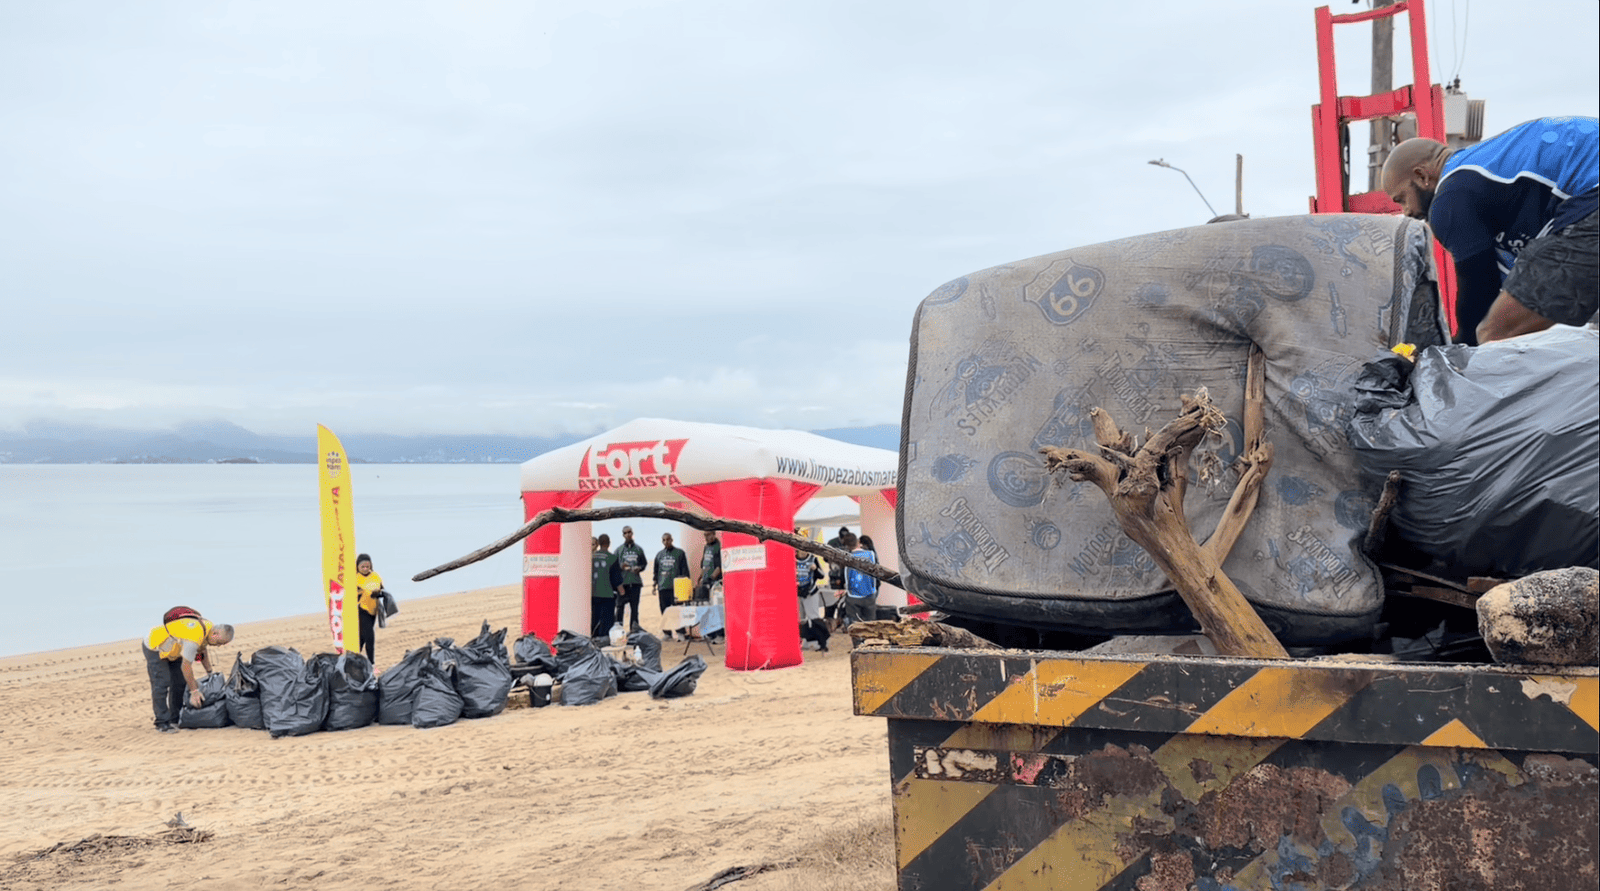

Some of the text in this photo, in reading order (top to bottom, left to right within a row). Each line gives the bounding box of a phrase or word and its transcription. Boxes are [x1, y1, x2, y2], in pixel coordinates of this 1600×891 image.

[1049, 274, 1096, 316] 66
[957, 351, 1043, 436] MOTORCYCLES
[1094, 350, 1162, 426] MOTORCYCLES
[579, 474, 682, 489] ATACADISTA
[588, 440, 672, 478] Fort
[776, 456, 898, 486] www.limpezadosmare
[939, 496, 1011, 574] MOTORCYCLES
[1286, 524, 1361, 599] MOTORCYCLES
